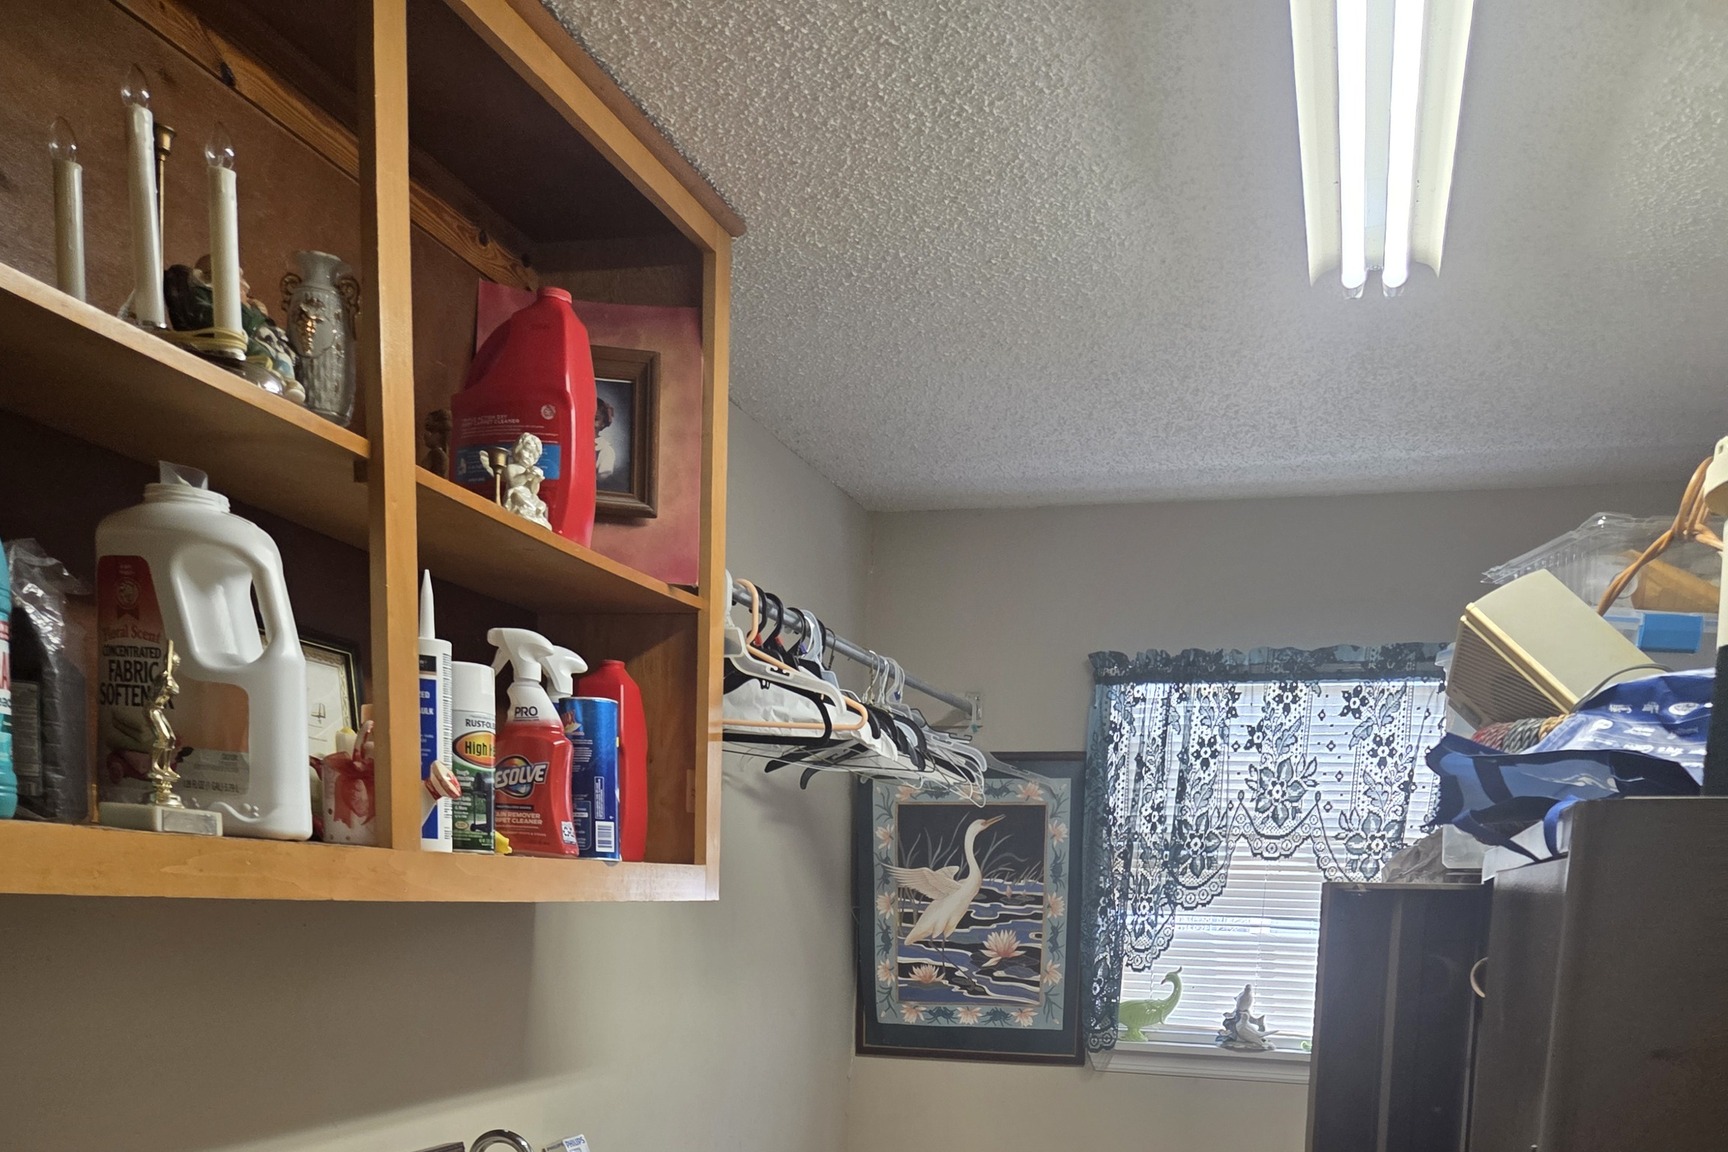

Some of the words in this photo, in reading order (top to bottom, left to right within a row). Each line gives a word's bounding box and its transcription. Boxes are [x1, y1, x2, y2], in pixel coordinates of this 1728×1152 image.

[108, 659, 160, 683] FABRIC
[514, 706, 539, 717] PRO
[464, 740, 488, 757] High
